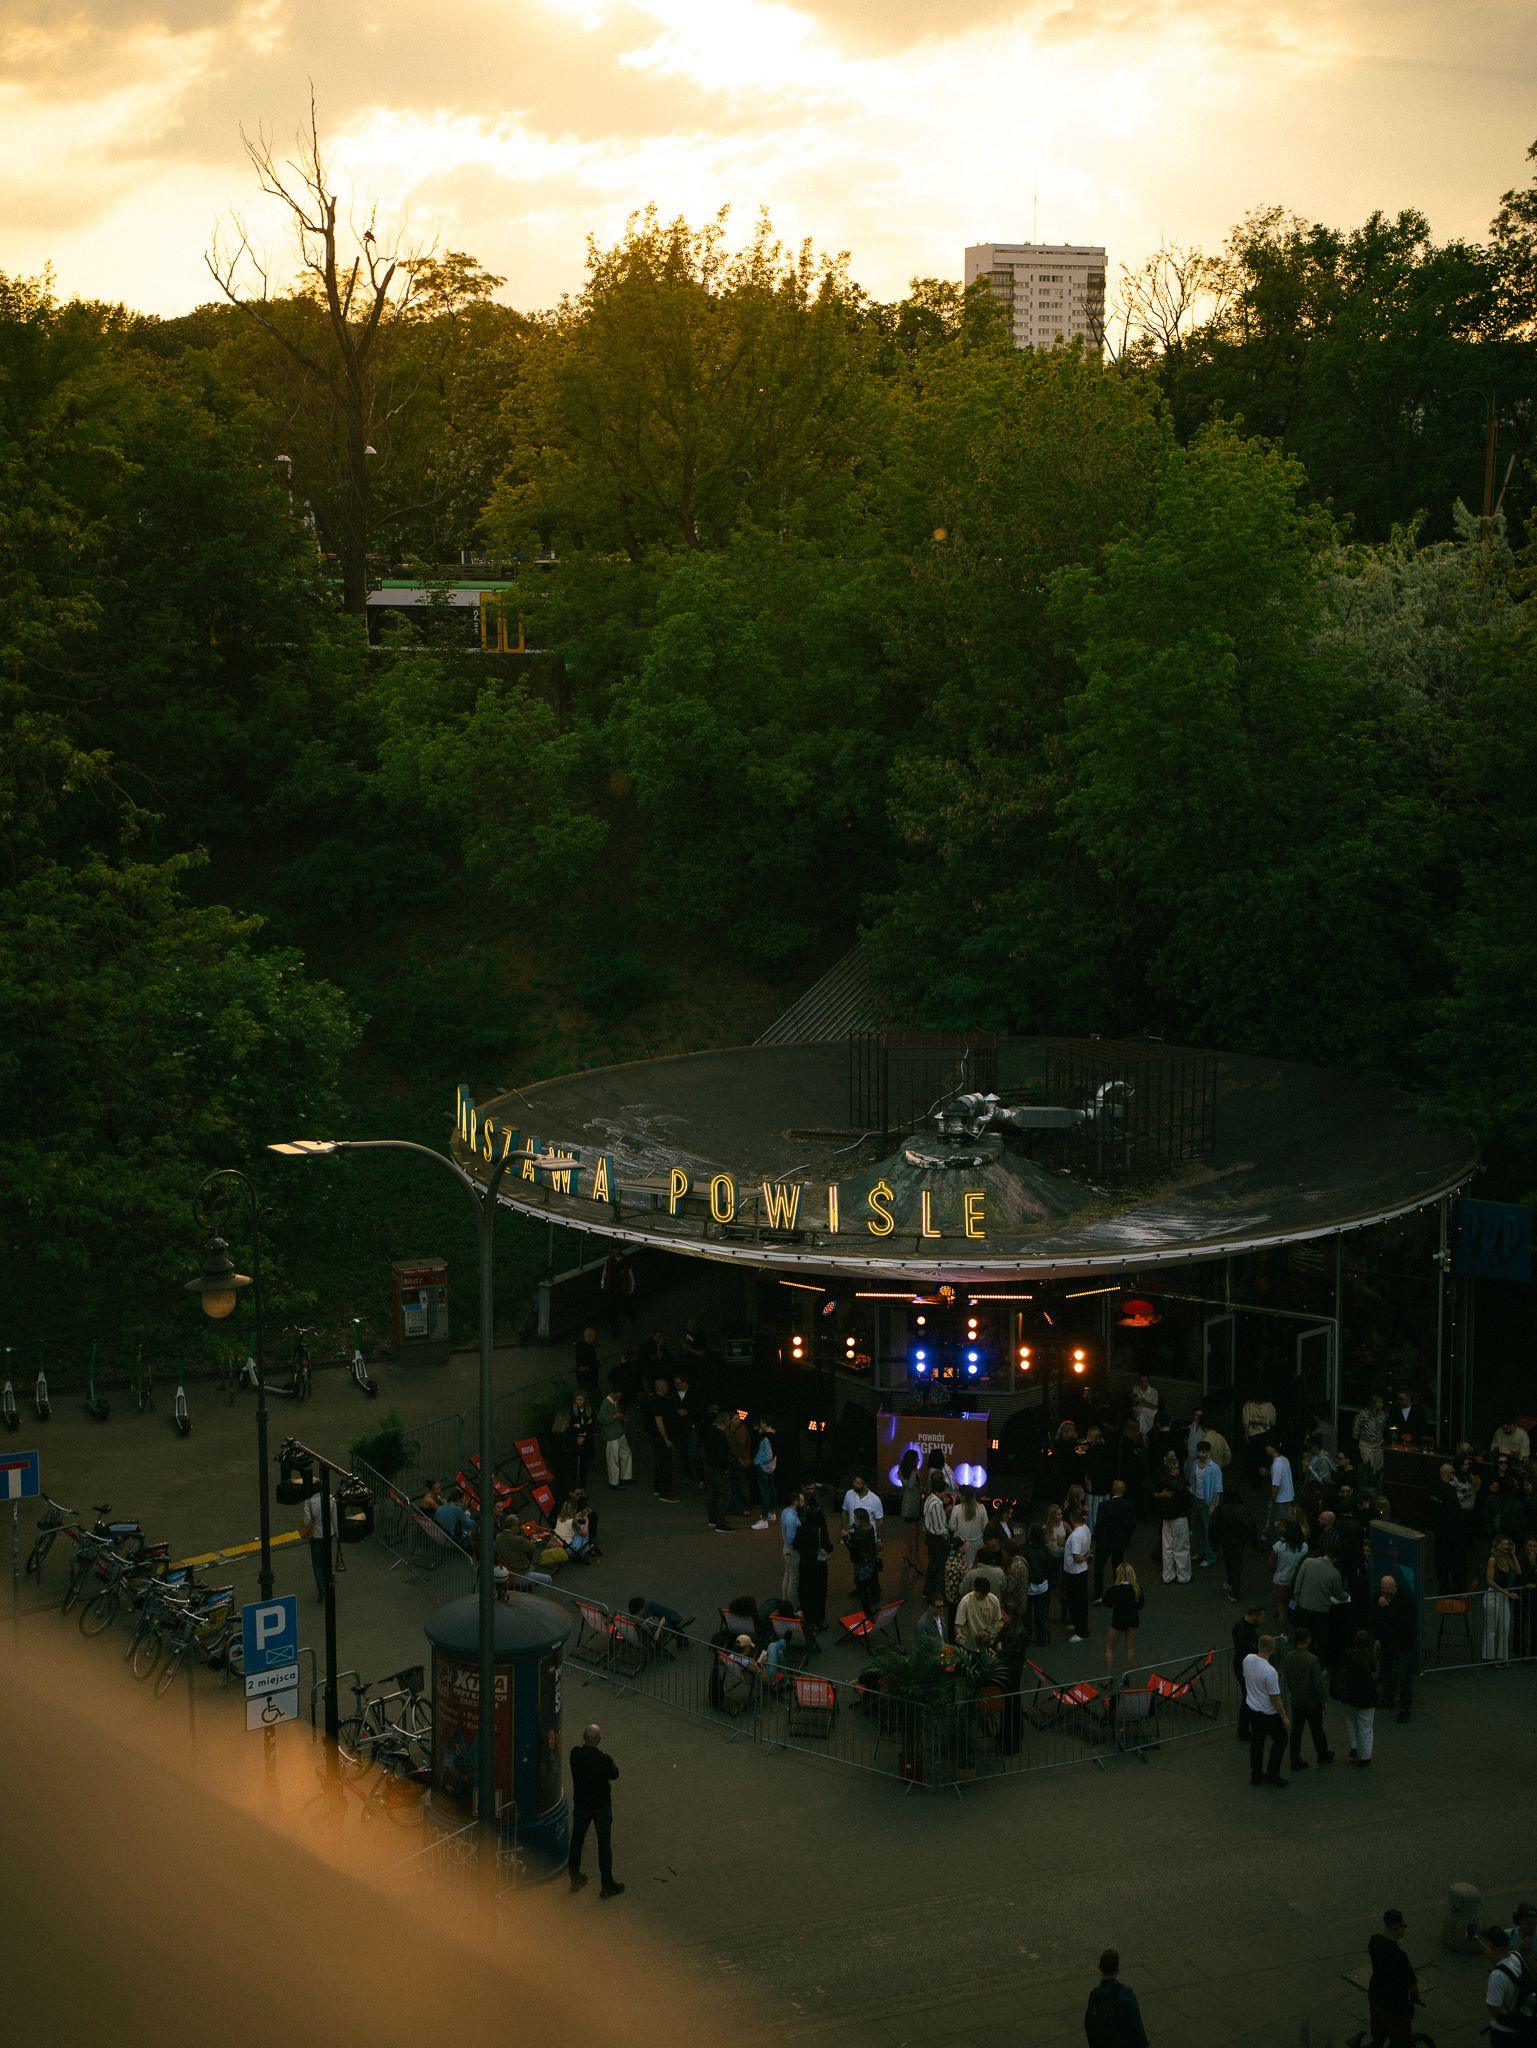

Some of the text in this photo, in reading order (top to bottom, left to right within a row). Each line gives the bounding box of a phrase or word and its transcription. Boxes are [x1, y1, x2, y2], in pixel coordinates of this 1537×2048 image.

[668, 1166, 988, 1240] POWIŚLE
[918, 1432, 946, 1442] POWRÓT
[255, 1605, 286, 1651] P
[248, 1673, 296, 1690] 2 miejsca
